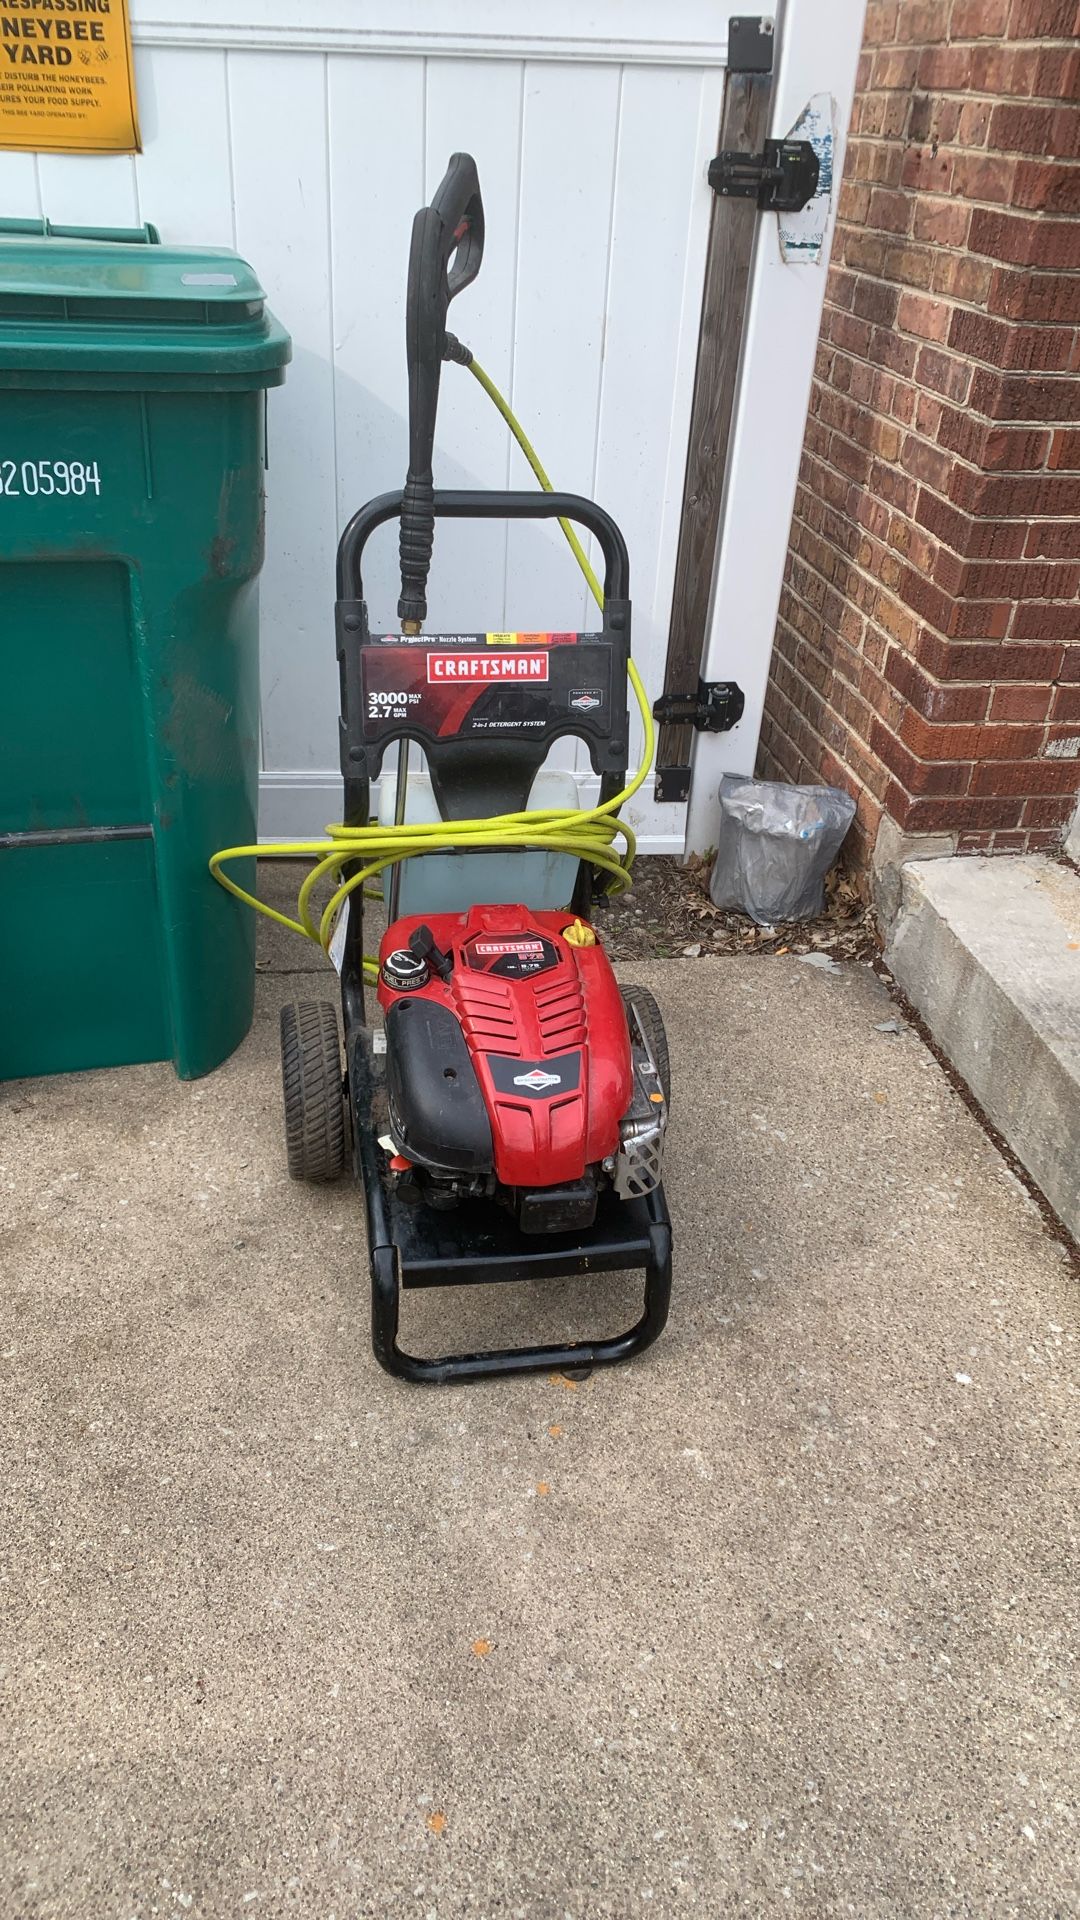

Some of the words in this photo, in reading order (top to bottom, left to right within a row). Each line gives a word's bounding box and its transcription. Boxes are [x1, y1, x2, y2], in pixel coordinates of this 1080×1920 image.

[2, 43, 72, 66] YARD
[4, 72, 40, 81] DISTURB
[42, 73, 56, 82] THE
[58, 74, 107, 85] HONEYBEES.
[0, 83, 15, 91] EIR
[17, 84, 66, 94] POLLINATING
[68, 86, 93, 95] WORK
[23, 95, 45, 104] YOUR
[47, 97, 69, 105] FOOD
[70, 98, 102, 107] SUPPLY.
[434, 658, 543, 676] CRAFTSMAN
[368, 692, 408, 705] 3000
[368, 705, 392, 718] 2.7
[479, 943, 538, 953] CRAFTSMAN
